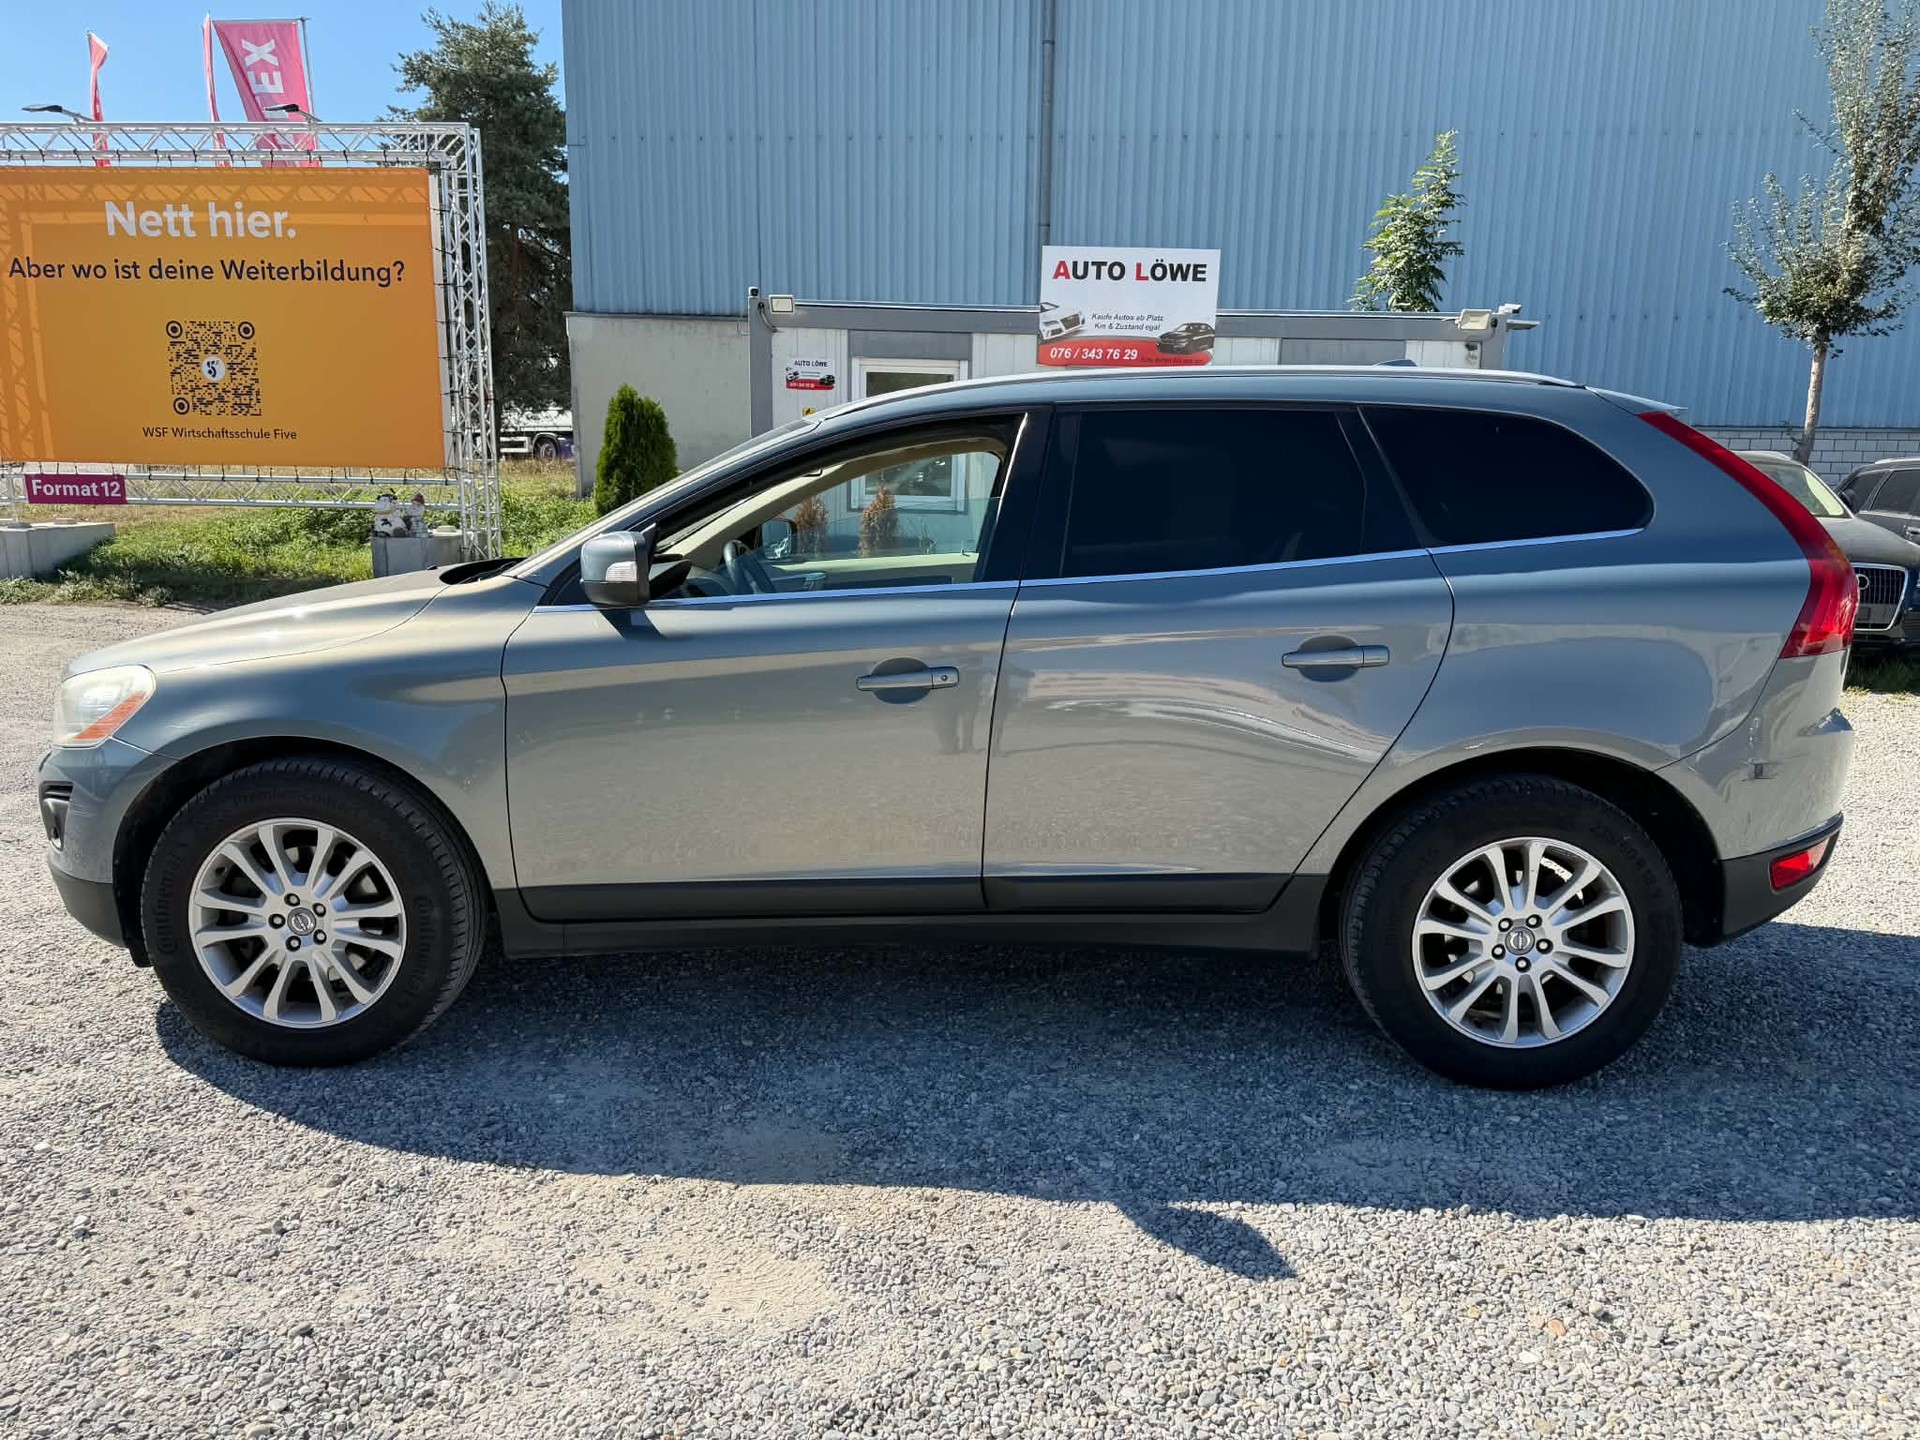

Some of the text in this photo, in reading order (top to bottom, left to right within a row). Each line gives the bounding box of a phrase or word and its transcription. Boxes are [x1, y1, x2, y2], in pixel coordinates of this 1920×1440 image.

[104, 200, 297, 238] Nett hier.
[8, 256, 405, 288] Aber wo ist deine Weiterbildung?
[1052, 259, 1207, 282] AUTO LÖWE
[1092, 313, 1112, 321] Kaufe
[1114, 313, 1134, 321] Autos
[1145, 323, 1161, 331] egal
[1050, 347, 1071, 359] 076
[1081, 348, 1102, 360] 343
[1106, 348, 1120, 360] 76
[1123, 348, 1138, 360] 29
[142, 427, 297, 440] WSF Wirtschaftsschule Five
